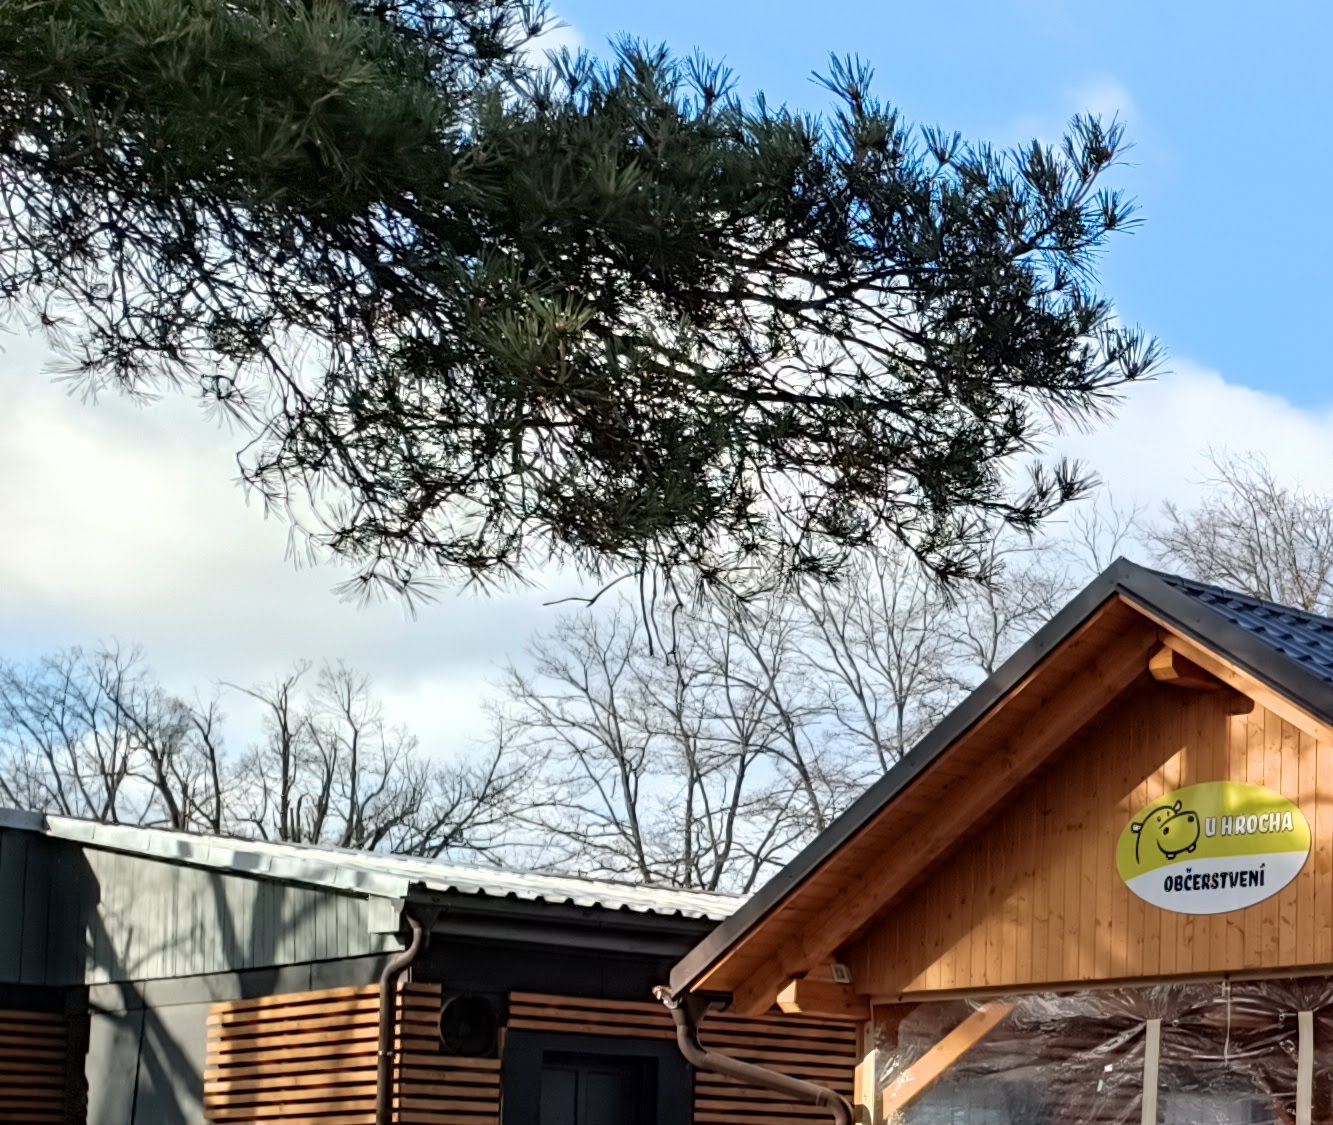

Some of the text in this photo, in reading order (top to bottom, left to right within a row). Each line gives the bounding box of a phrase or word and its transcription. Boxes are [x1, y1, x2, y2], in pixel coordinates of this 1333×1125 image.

[1205, 811, 1294, 838] U HROCHA
[1164, 863, 1266, 892] OBČERSTVENÍ
